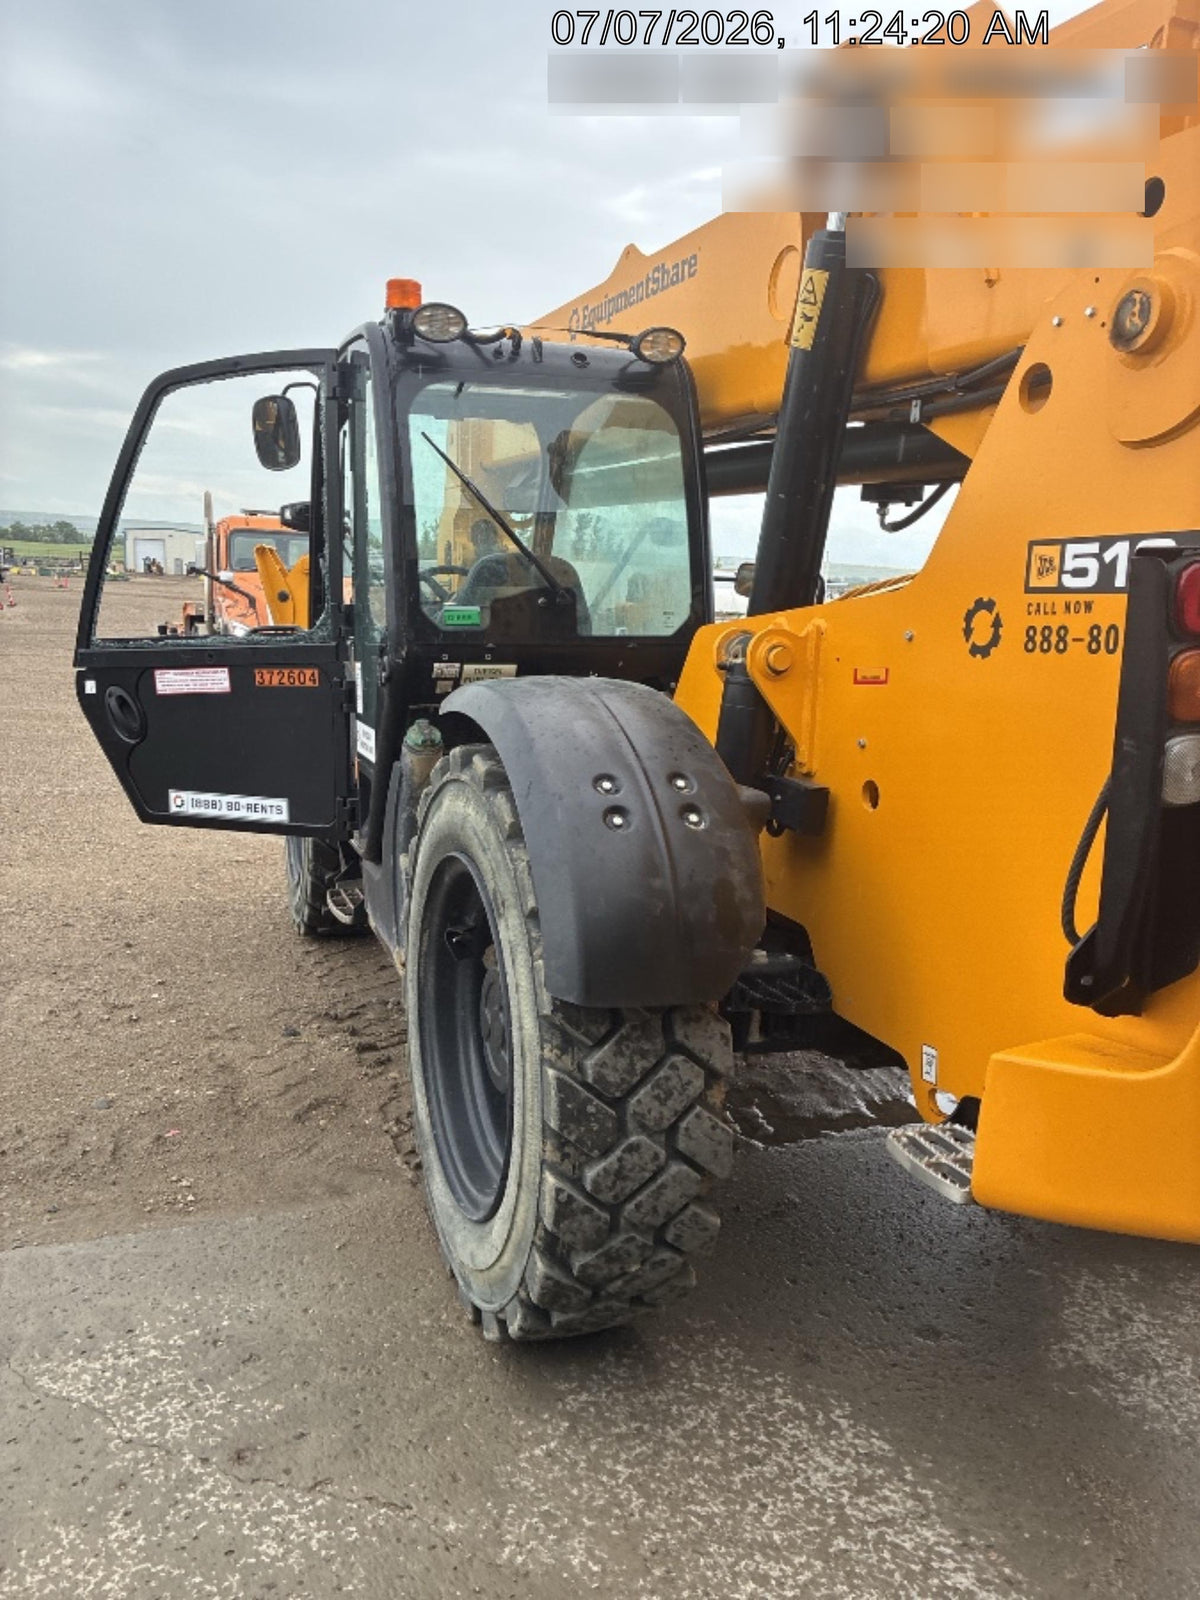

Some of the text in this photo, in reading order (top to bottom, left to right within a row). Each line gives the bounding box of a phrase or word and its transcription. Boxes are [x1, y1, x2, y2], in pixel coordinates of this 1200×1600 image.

[582, 254, 698, 331] EquipmentShare
[1061, 538, 1177, 589] 51
[1026, 600, 1095, 616] CALL NOW
[256, 670, 317, 686] 372604
